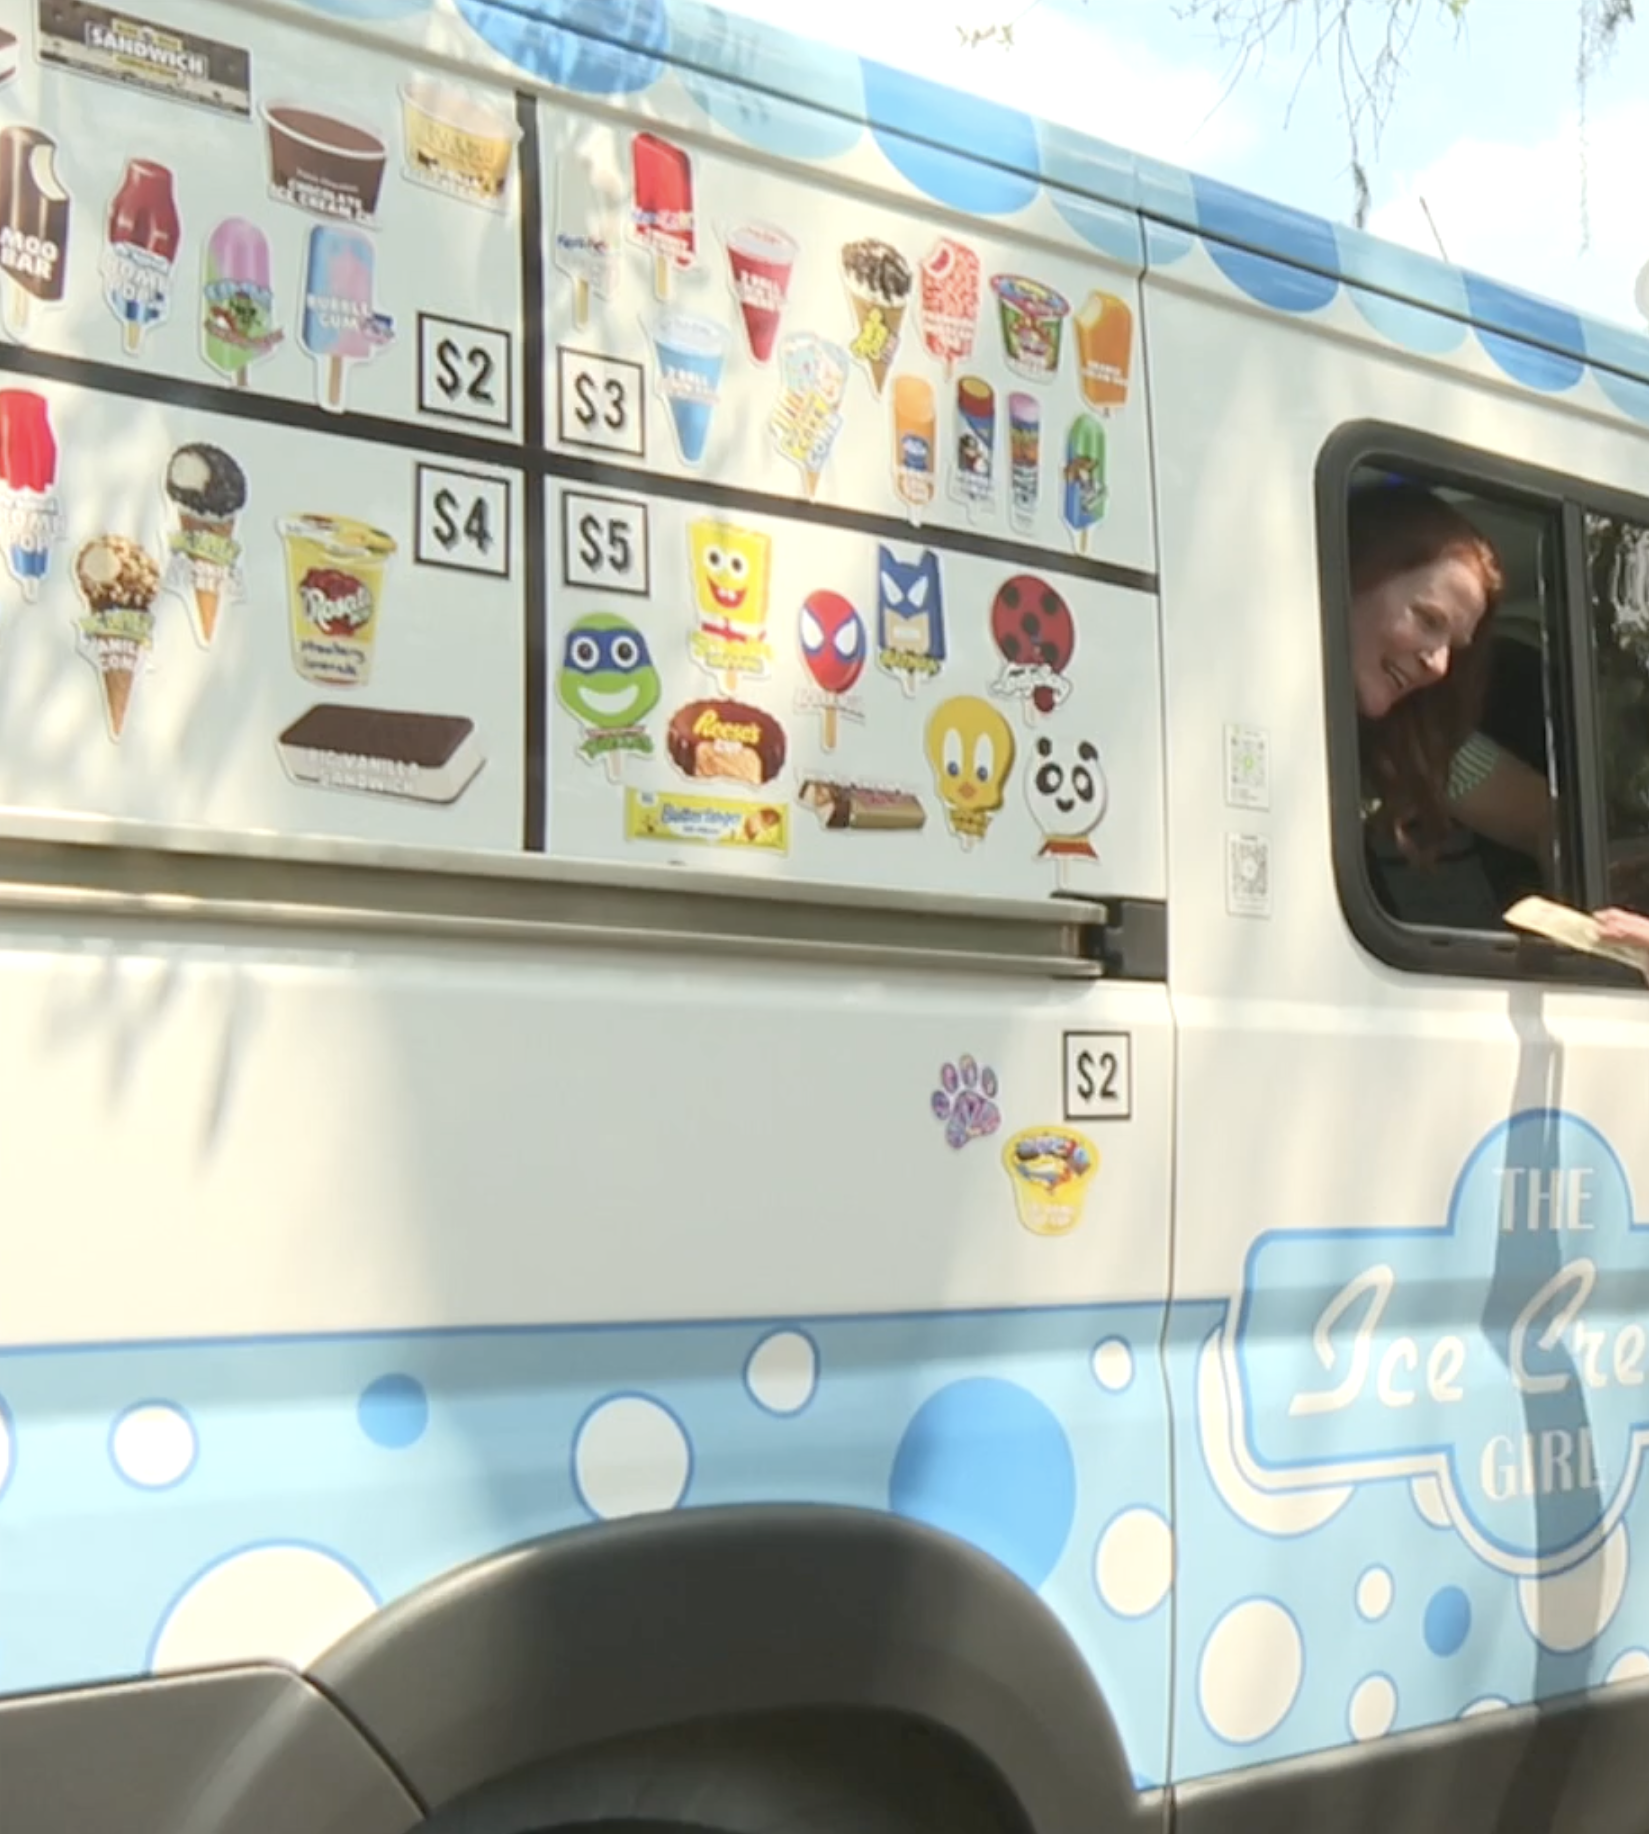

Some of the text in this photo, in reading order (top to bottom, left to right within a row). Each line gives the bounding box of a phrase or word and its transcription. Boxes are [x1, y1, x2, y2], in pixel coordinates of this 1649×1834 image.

[92, 27, 204, 75] SANDWICH
[0, 226, 58, 262] MOO
[0, 250, 52, 281] BAR
[436, 338, 495, 405] $2
[575, 371, 626, 430] $3
[432, 487, 492, 553] $4
[579, 513, 631, 573] $5
[1076, 1050, 1118, 1102] $2
[1491, 1167, 1596, 1232] THE
[1288, 1263, 1467, 1417] Ice
[1480, 1427, 1608, 1501] GIRL
